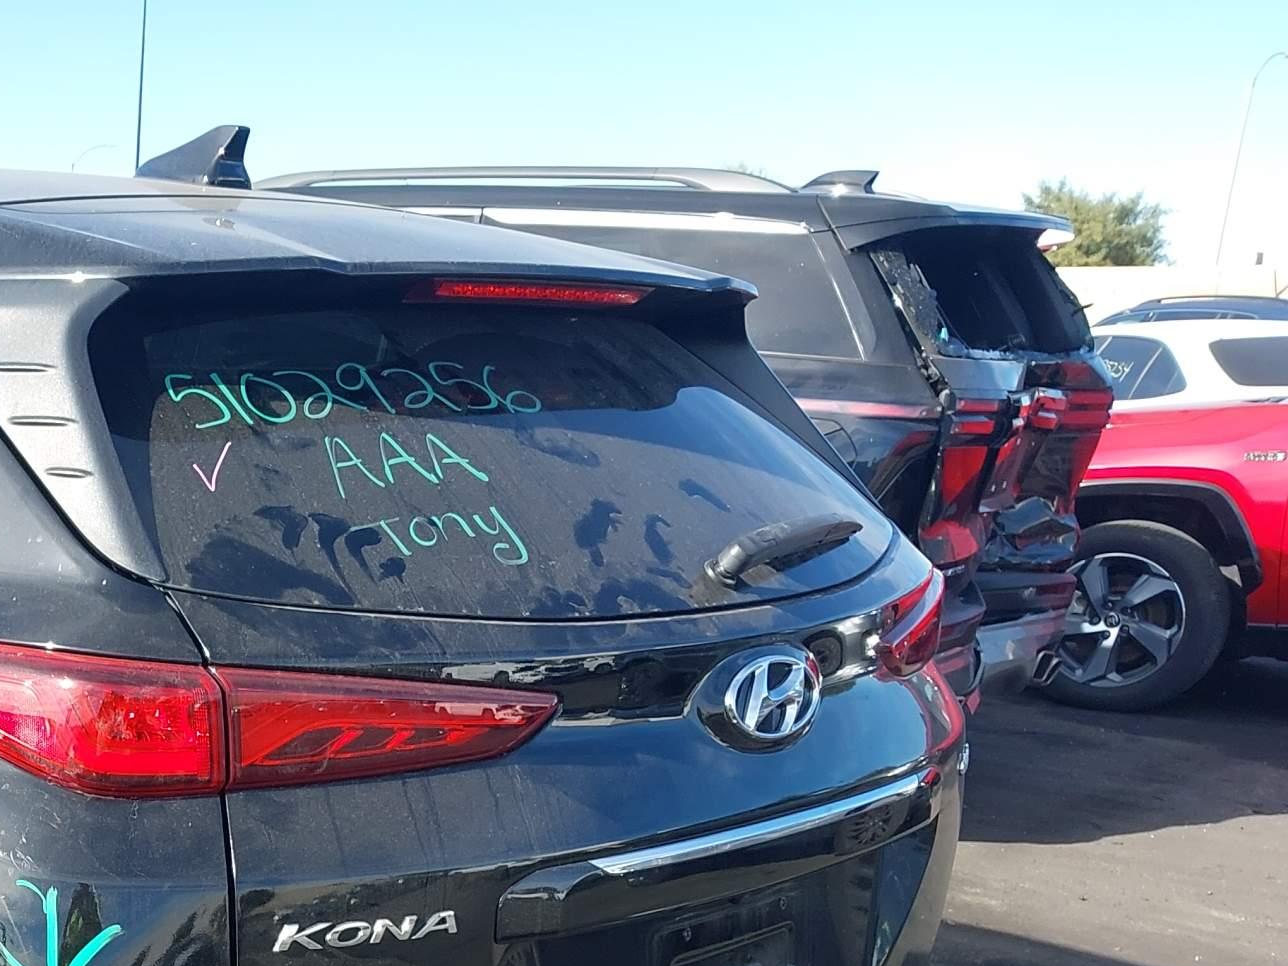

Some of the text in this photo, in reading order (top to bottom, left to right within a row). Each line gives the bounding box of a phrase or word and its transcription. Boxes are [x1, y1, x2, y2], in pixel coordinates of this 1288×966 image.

[165, 362, 542, 429] 51029256
[323, 431, 490, 499] AAA
[349, 506, 530, 566] Tony
[272, 909, 458, 953] KONA
